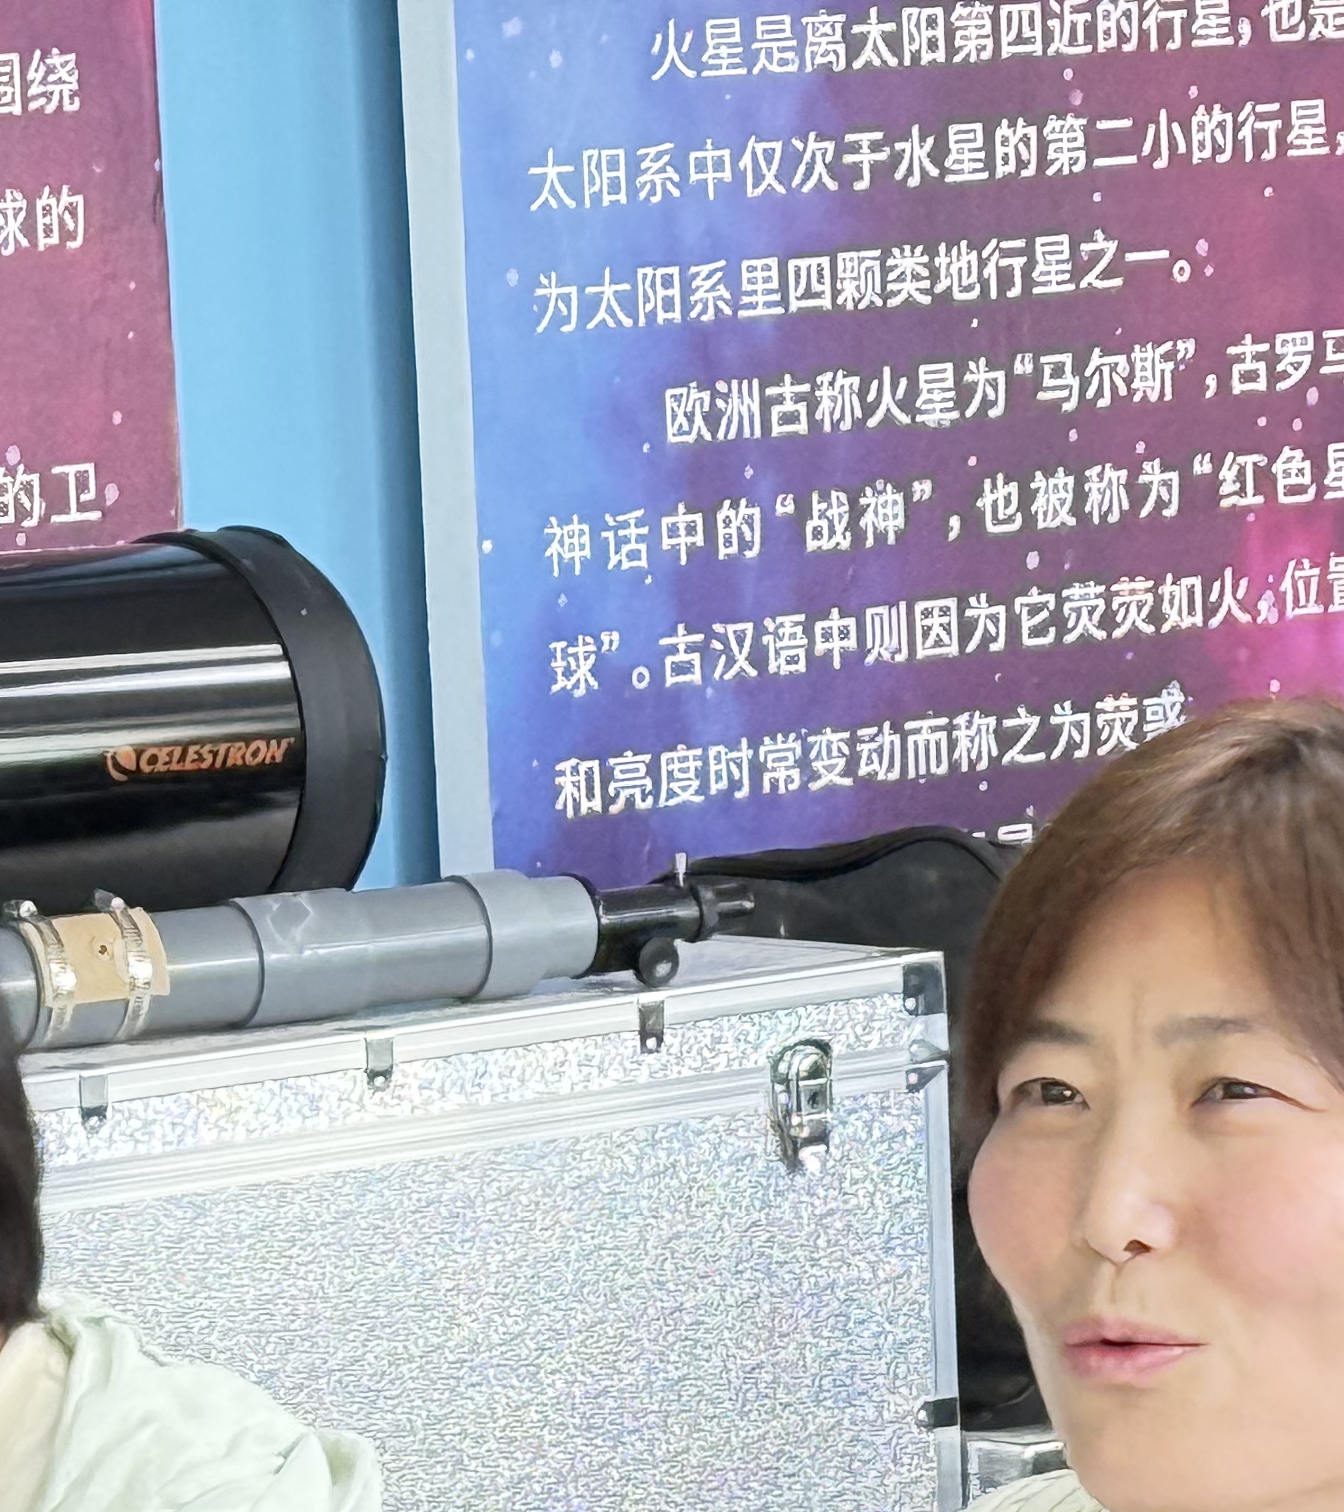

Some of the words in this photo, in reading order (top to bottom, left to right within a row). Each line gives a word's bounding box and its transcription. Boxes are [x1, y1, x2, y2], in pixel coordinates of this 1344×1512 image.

[534, 229, 1192, 334] 为太阳系里四颗类地行星之一。
[139, 738, 291, 774] CELESTRON
